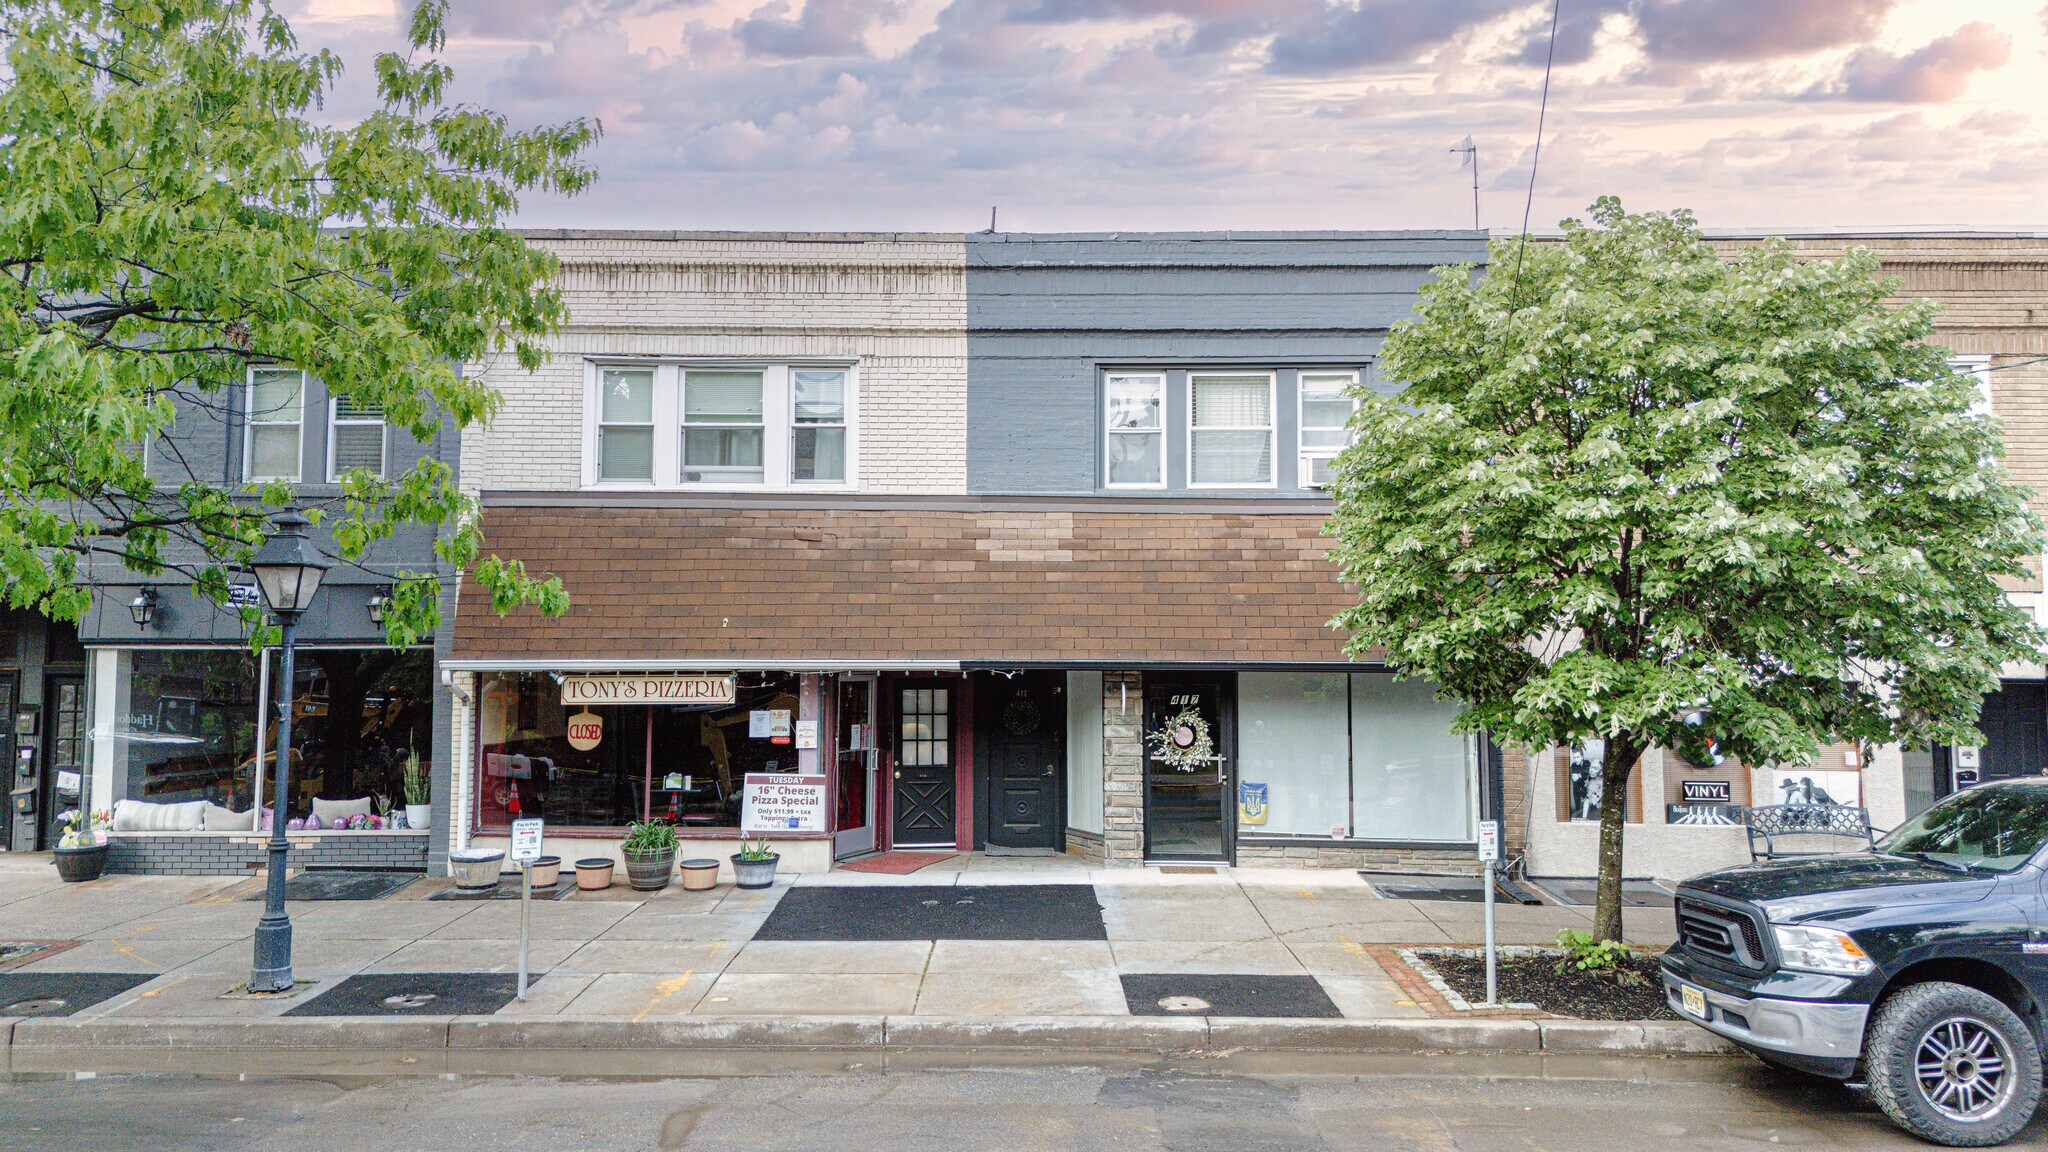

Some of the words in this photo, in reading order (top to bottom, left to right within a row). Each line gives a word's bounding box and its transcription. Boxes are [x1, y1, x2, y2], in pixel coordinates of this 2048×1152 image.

[568, 681, 637, 698] TONY'S
[643, 680, 728, 699] PIZZERIA
[1171, 695, 1199, 704] 417
[569, 724, 602, 740] CLOSED
[768, 776, 805, 784] TUESDAY
[758, 786, 775, 795] 16"
[778, 786, 816, 796] Cheese
[1684, 786, 1728, 797] VINYL
[751, 795, 778, 805] Pizza
[780, 796, 819, 807] Special
